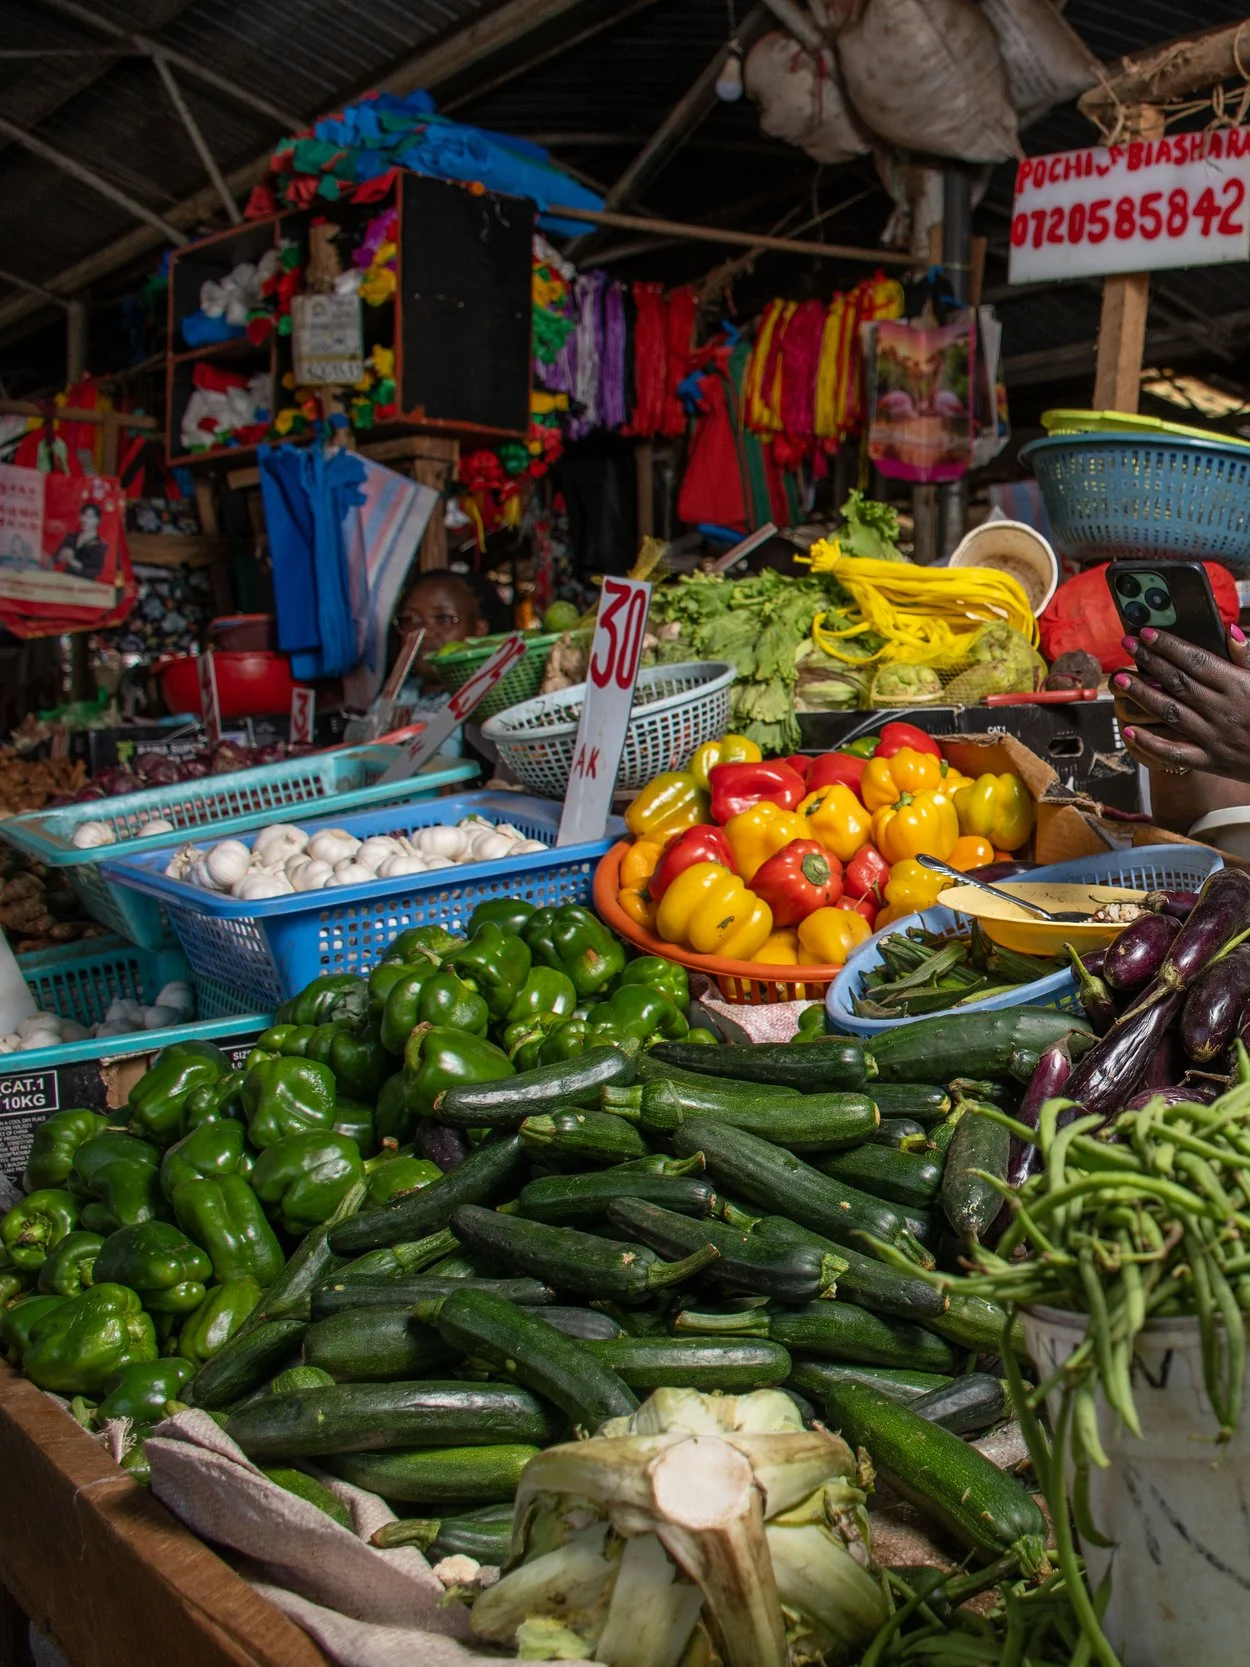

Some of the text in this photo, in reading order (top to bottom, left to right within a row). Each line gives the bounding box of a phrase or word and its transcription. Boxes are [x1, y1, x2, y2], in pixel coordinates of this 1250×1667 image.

[1015, 151, 1092, 195] POCHI
[1011, 178, 1245, 249] 0720585842
[590, 579, 646, 690] 30
[574, 743, 600, 779] AK
[1, 1077, 44, 1095] CAT.1
[3, 1093, 46, 1110] 10KG
